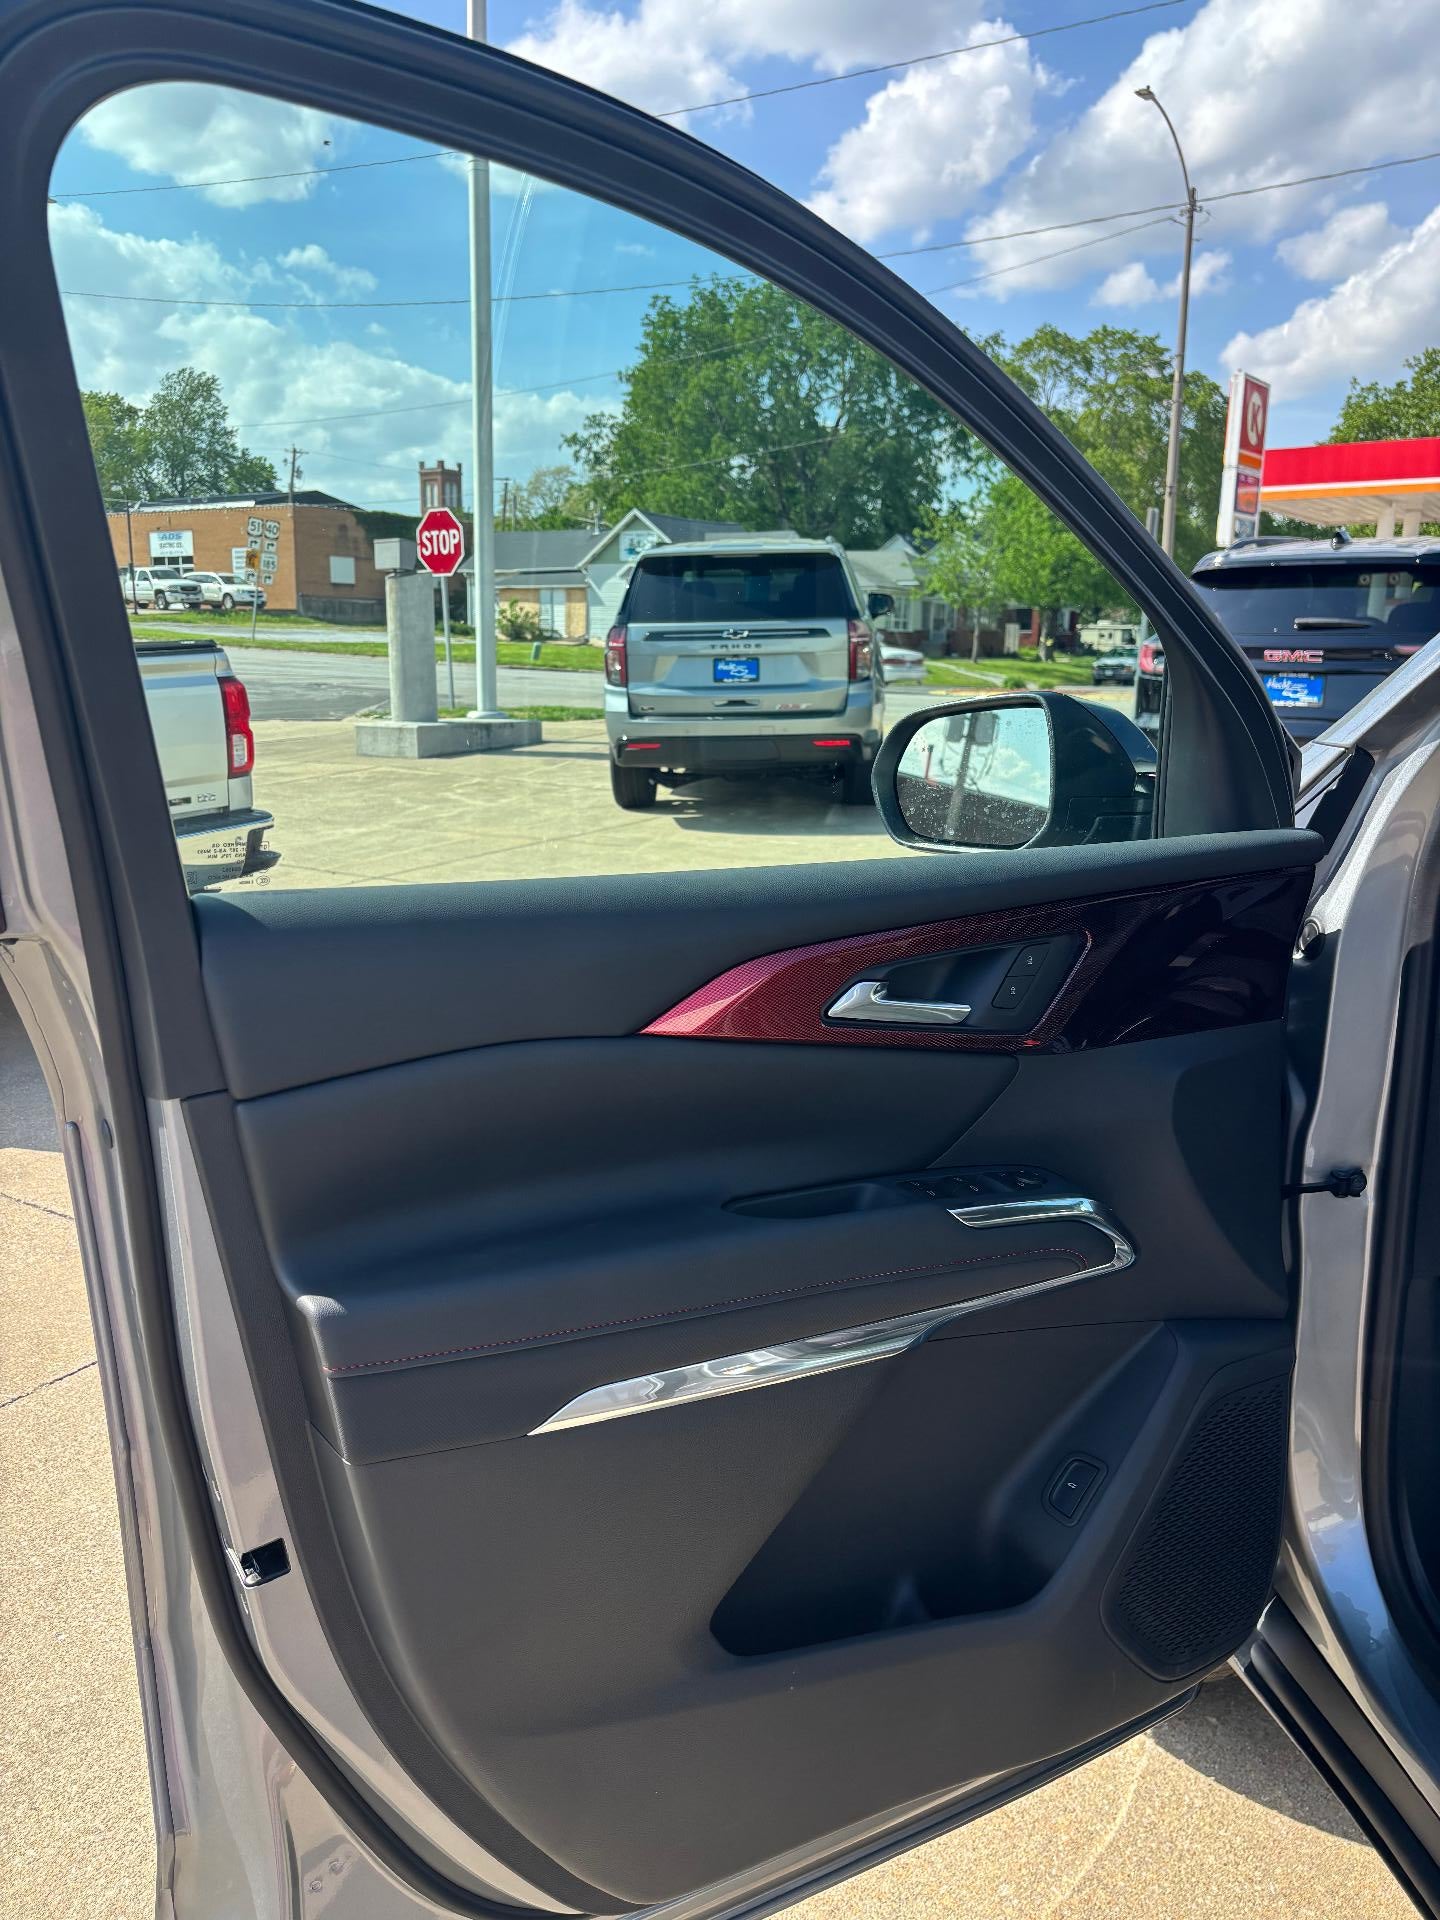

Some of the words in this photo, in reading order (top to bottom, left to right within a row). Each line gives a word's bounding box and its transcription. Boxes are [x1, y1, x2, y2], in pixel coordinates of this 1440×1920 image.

[250, 521, 260, 532] 51
[265, 523, 278, 535] 40
[421, 528, 460, 557] STOP
[1264, 649, 1324, 664] GMC
